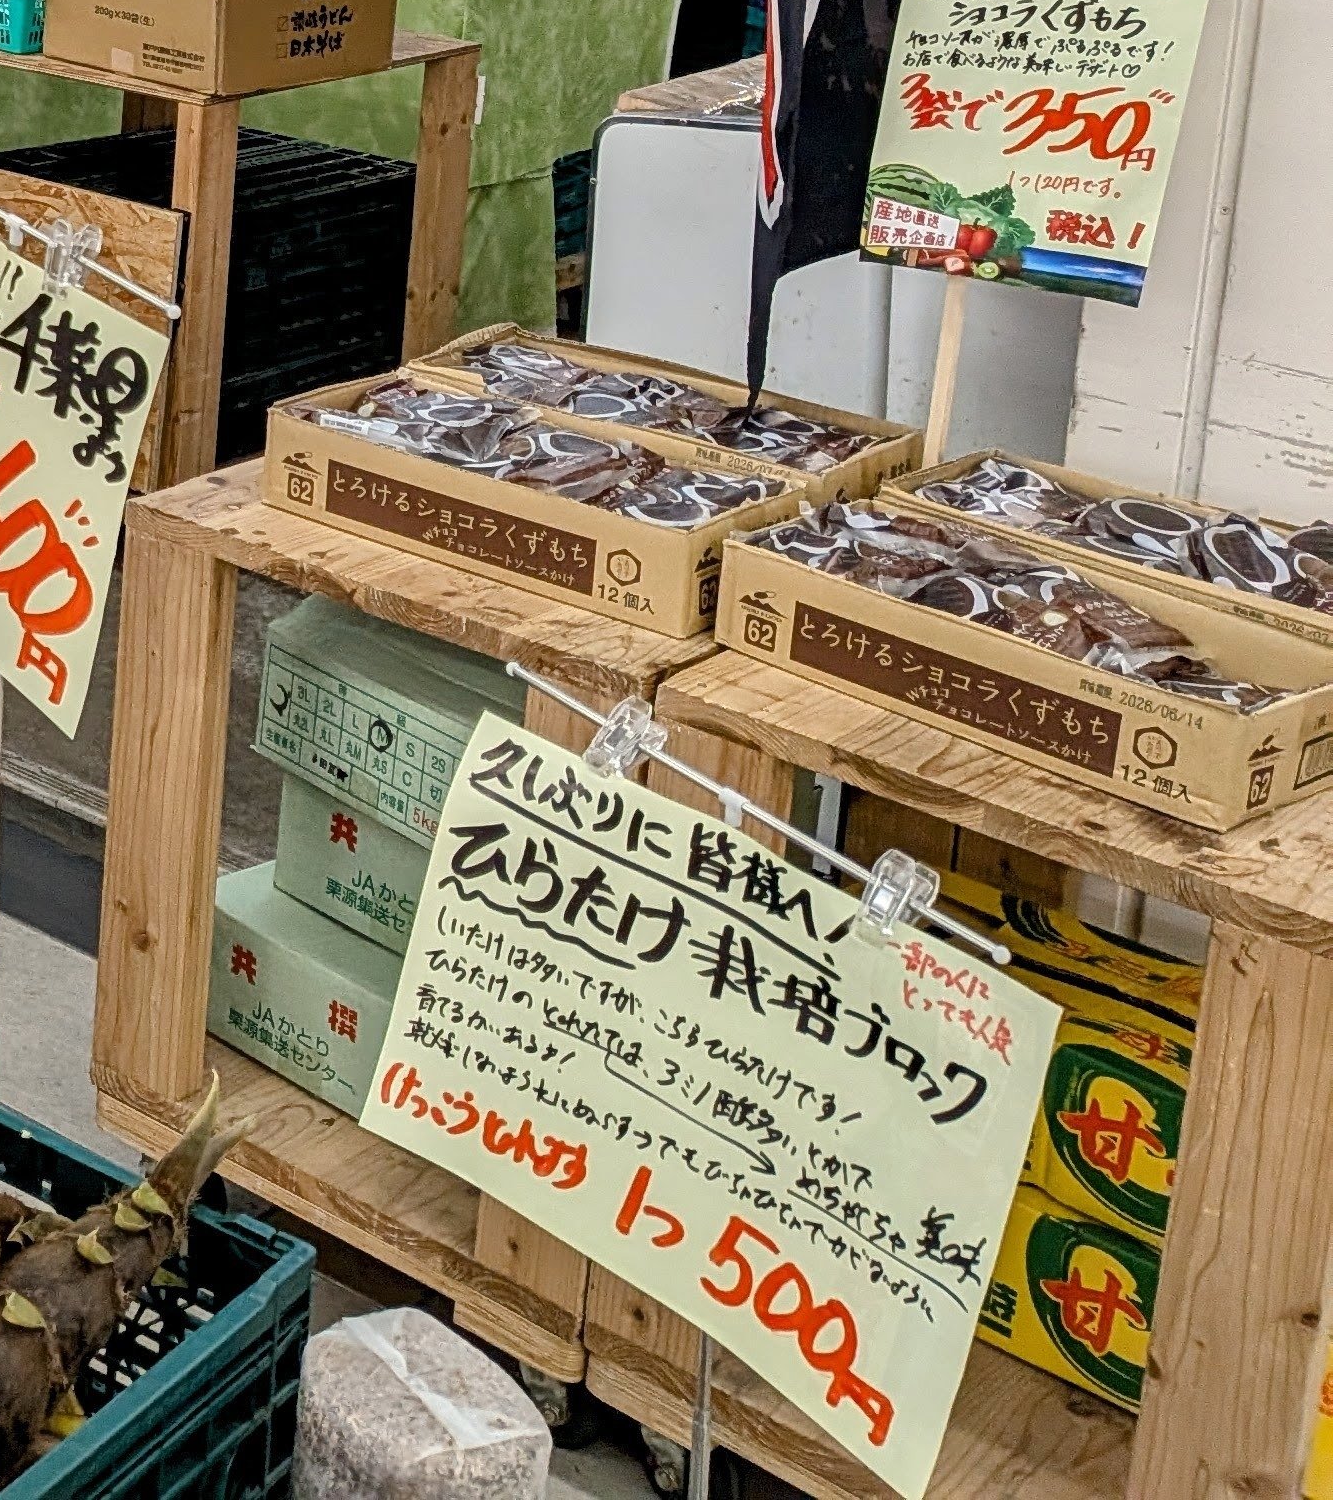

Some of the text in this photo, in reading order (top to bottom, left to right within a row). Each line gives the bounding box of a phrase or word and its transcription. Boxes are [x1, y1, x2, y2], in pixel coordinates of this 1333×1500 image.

[873, 199, 942, 230] 産地直送
[1044, 208, 1148, 250] 税込!
[289, 478, 313, 503] 62
[332, 468, 590, 570] とろけるショコラくずもち
[747, 621, 775, 649] 62
[799, 611, 1112, 747] とろけるショコラくずもち
[405, 741, 416, 758] S
[931, 697, 1093, 764] チョコレートソースかけ
[401, 770, 413, 787] C
[251, 999, 331, 1058] JAかとり
[698, 1216, 897, 1449] 500円
